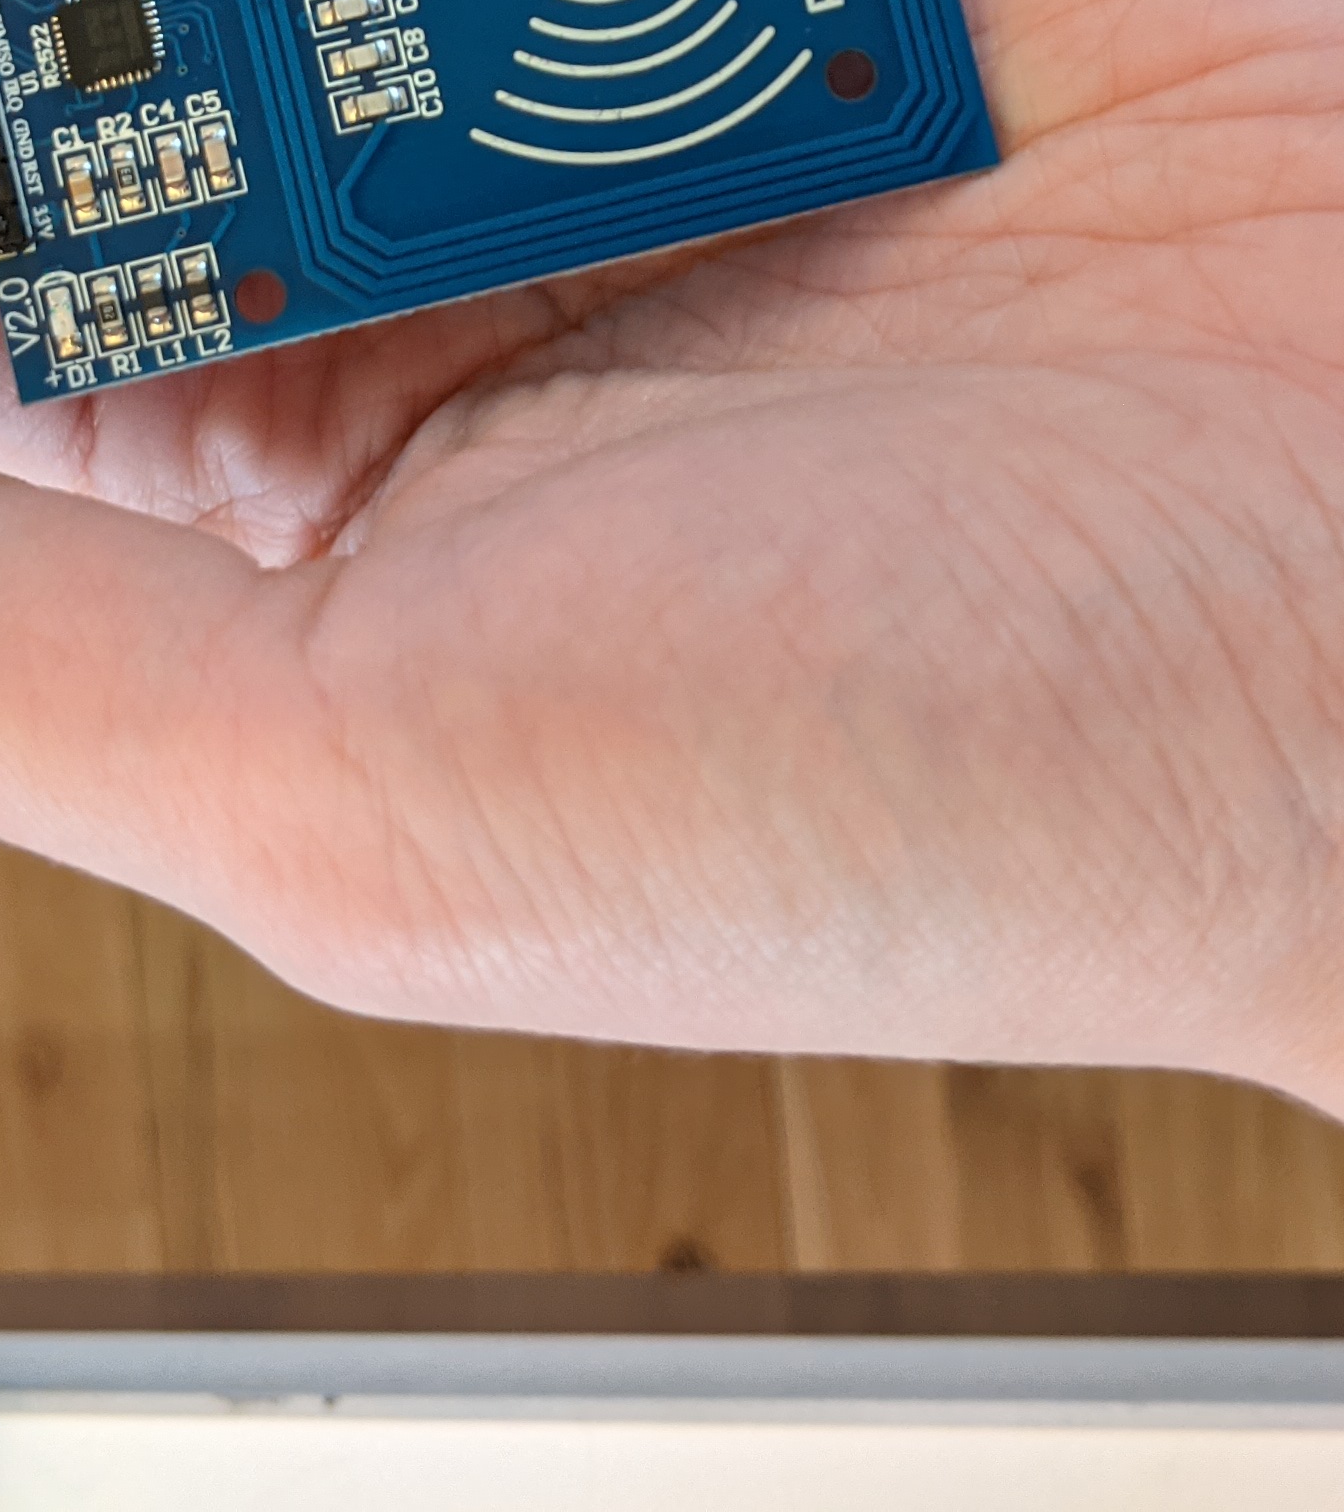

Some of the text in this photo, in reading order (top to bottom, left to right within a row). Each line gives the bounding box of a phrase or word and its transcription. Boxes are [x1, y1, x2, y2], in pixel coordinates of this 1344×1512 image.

[30, 22, 62, 90] RC522
[403, 27, 430, 64] C8
[19, 69, 40, 95] U1
[413, 68, 444, 118] C10
[12, 118, 35, 160] GND
[51, 89, 222, 149] C1 R2 C4 C5
[21, 159, 45, 196] RST
[110, 350, 143, 377] R1
[156, 339, 187, 367] L1
[196, 328, 233, 357] L2
